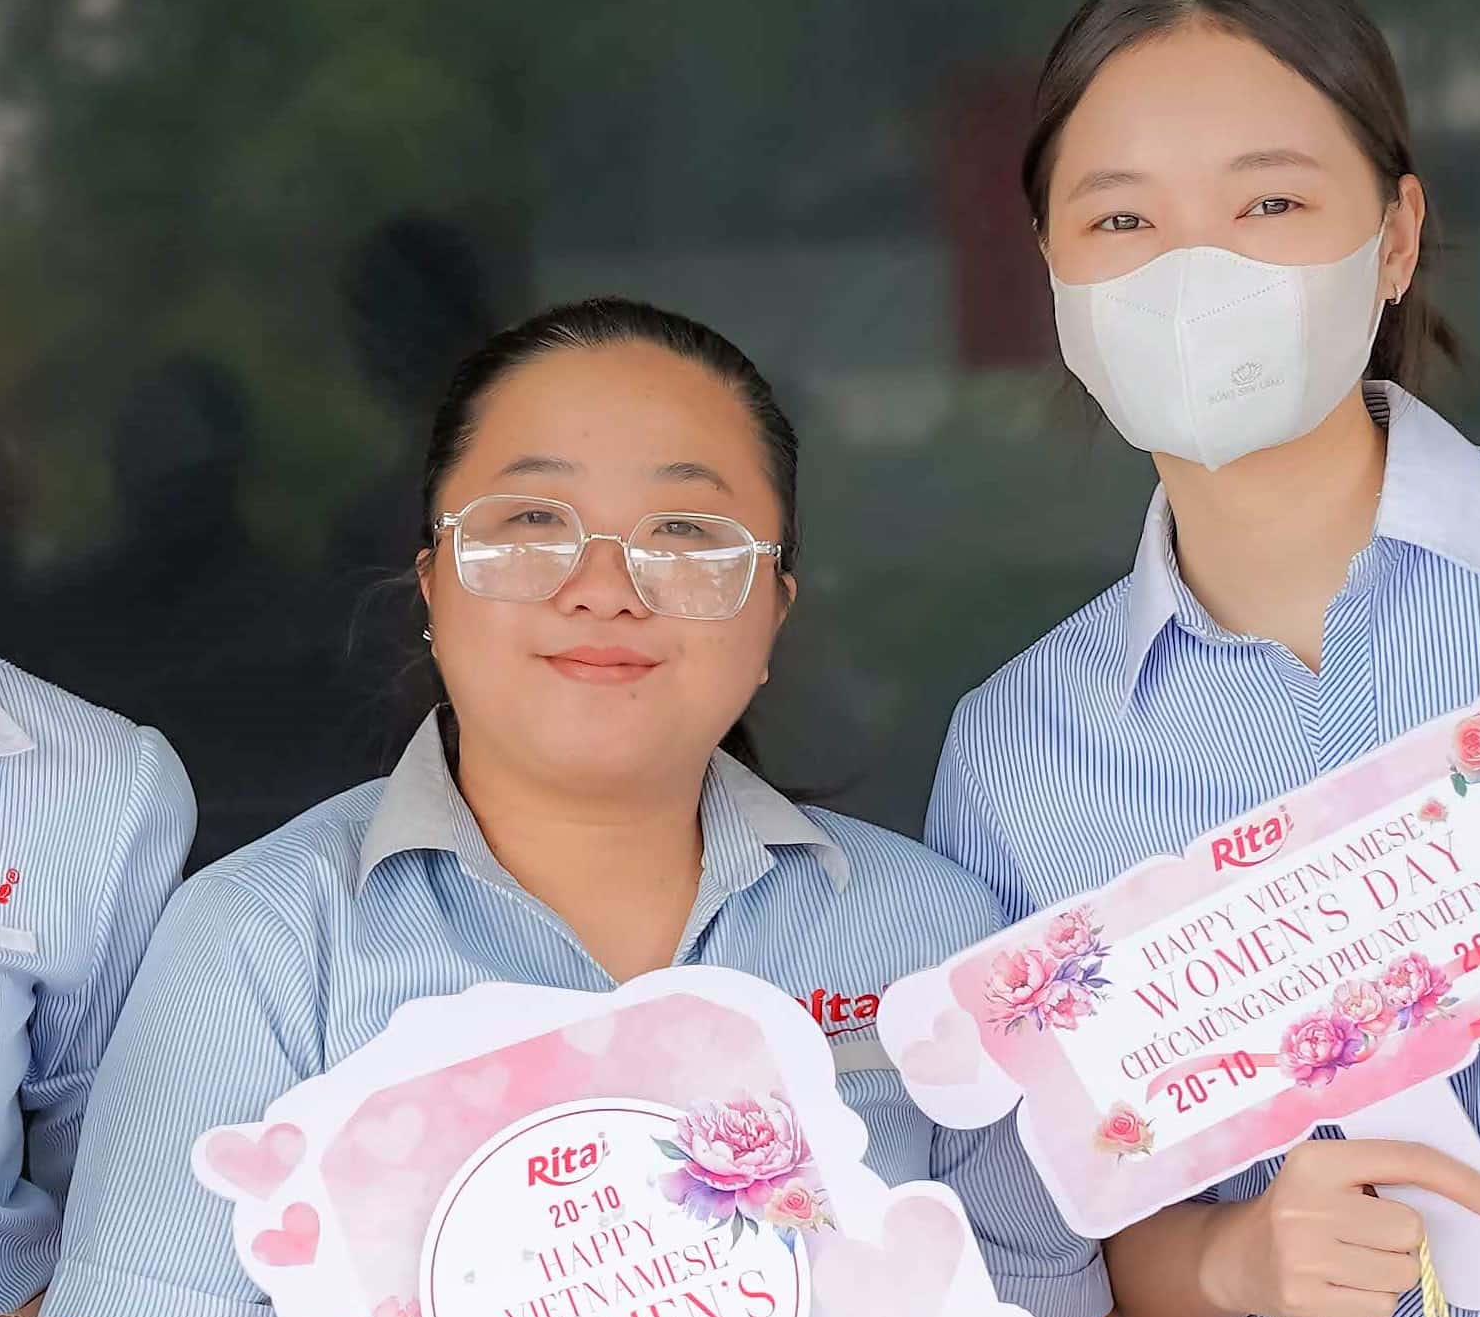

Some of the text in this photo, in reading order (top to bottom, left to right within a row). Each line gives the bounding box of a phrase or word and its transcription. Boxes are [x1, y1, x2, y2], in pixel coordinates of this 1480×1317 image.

[1211, 815, 1283, 871] Rita
[1142, 812, 1424, 971] HAPPY VIETNAMESE
[1133, 829, 1463, 1019] WOMEN'S DAY
[795, 988, 880, 1027] ita
[1121, 1031, 1190, 1081] CHÚC
[1260, 955, 1329, 1015] NGÀY
[1327, 933, 1383, 978] PHỤ
[1418, 886, 1475, 930] VIỆT
[1167, 1050, 1257, 1113] 20-10
[528, 1142, 598, 1187] Rita
[549, 1185, 621, 1228] 20-10
[539, 1215, 656, 1282] HAPPY
